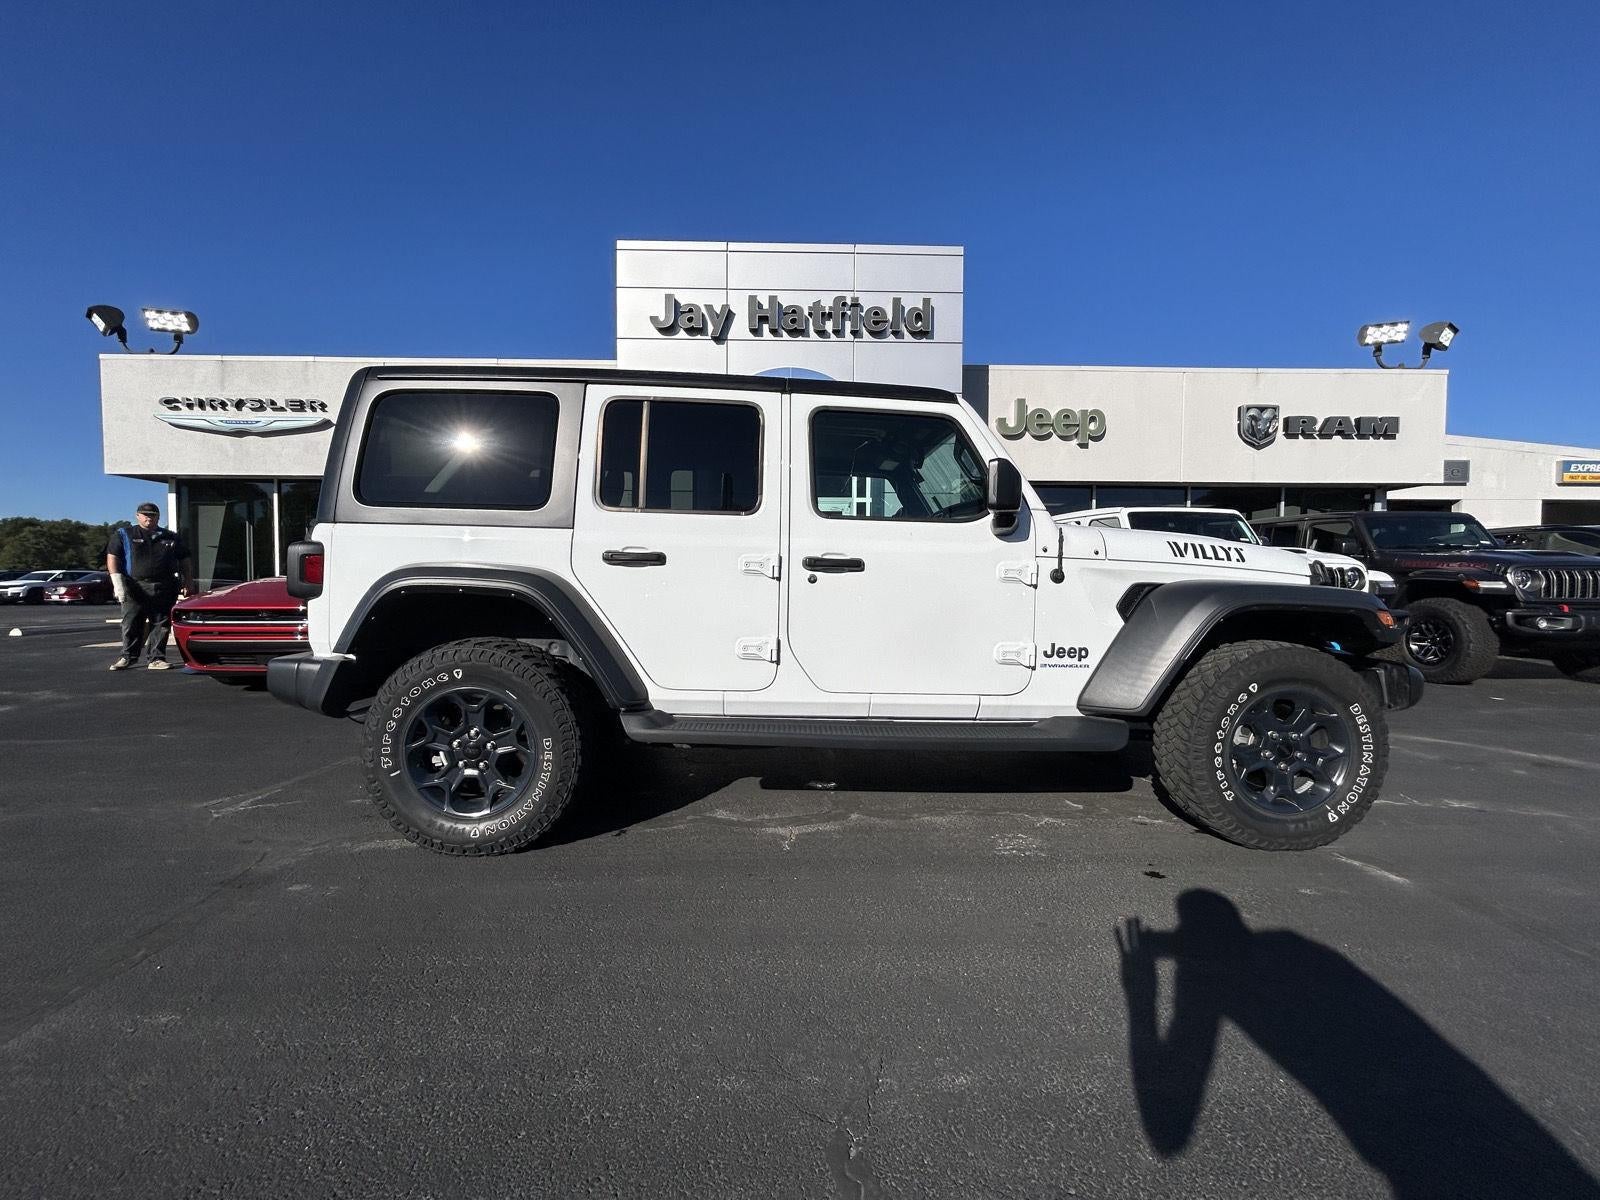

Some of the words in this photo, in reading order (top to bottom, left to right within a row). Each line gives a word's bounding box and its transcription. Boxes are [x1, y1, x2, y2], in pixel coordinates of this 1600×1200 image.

[649, 293, 731, 339] Jay
[747, 295, 933, 337] Hatfield
[159, 396, 328, 412] CHRYSLER
[996, 398, 1107, 446] Jeep
[1282, 415, 1400, 440] RAM
[1166, 540, 1246, 563] WILLYS
[1043, 642, 1089, 662] Jeep
[380, 672, 449, 768] Firestone
[1337, 702, 1375, 815] DESTINATION
[485, 737, 553, 836] DESTINATION
